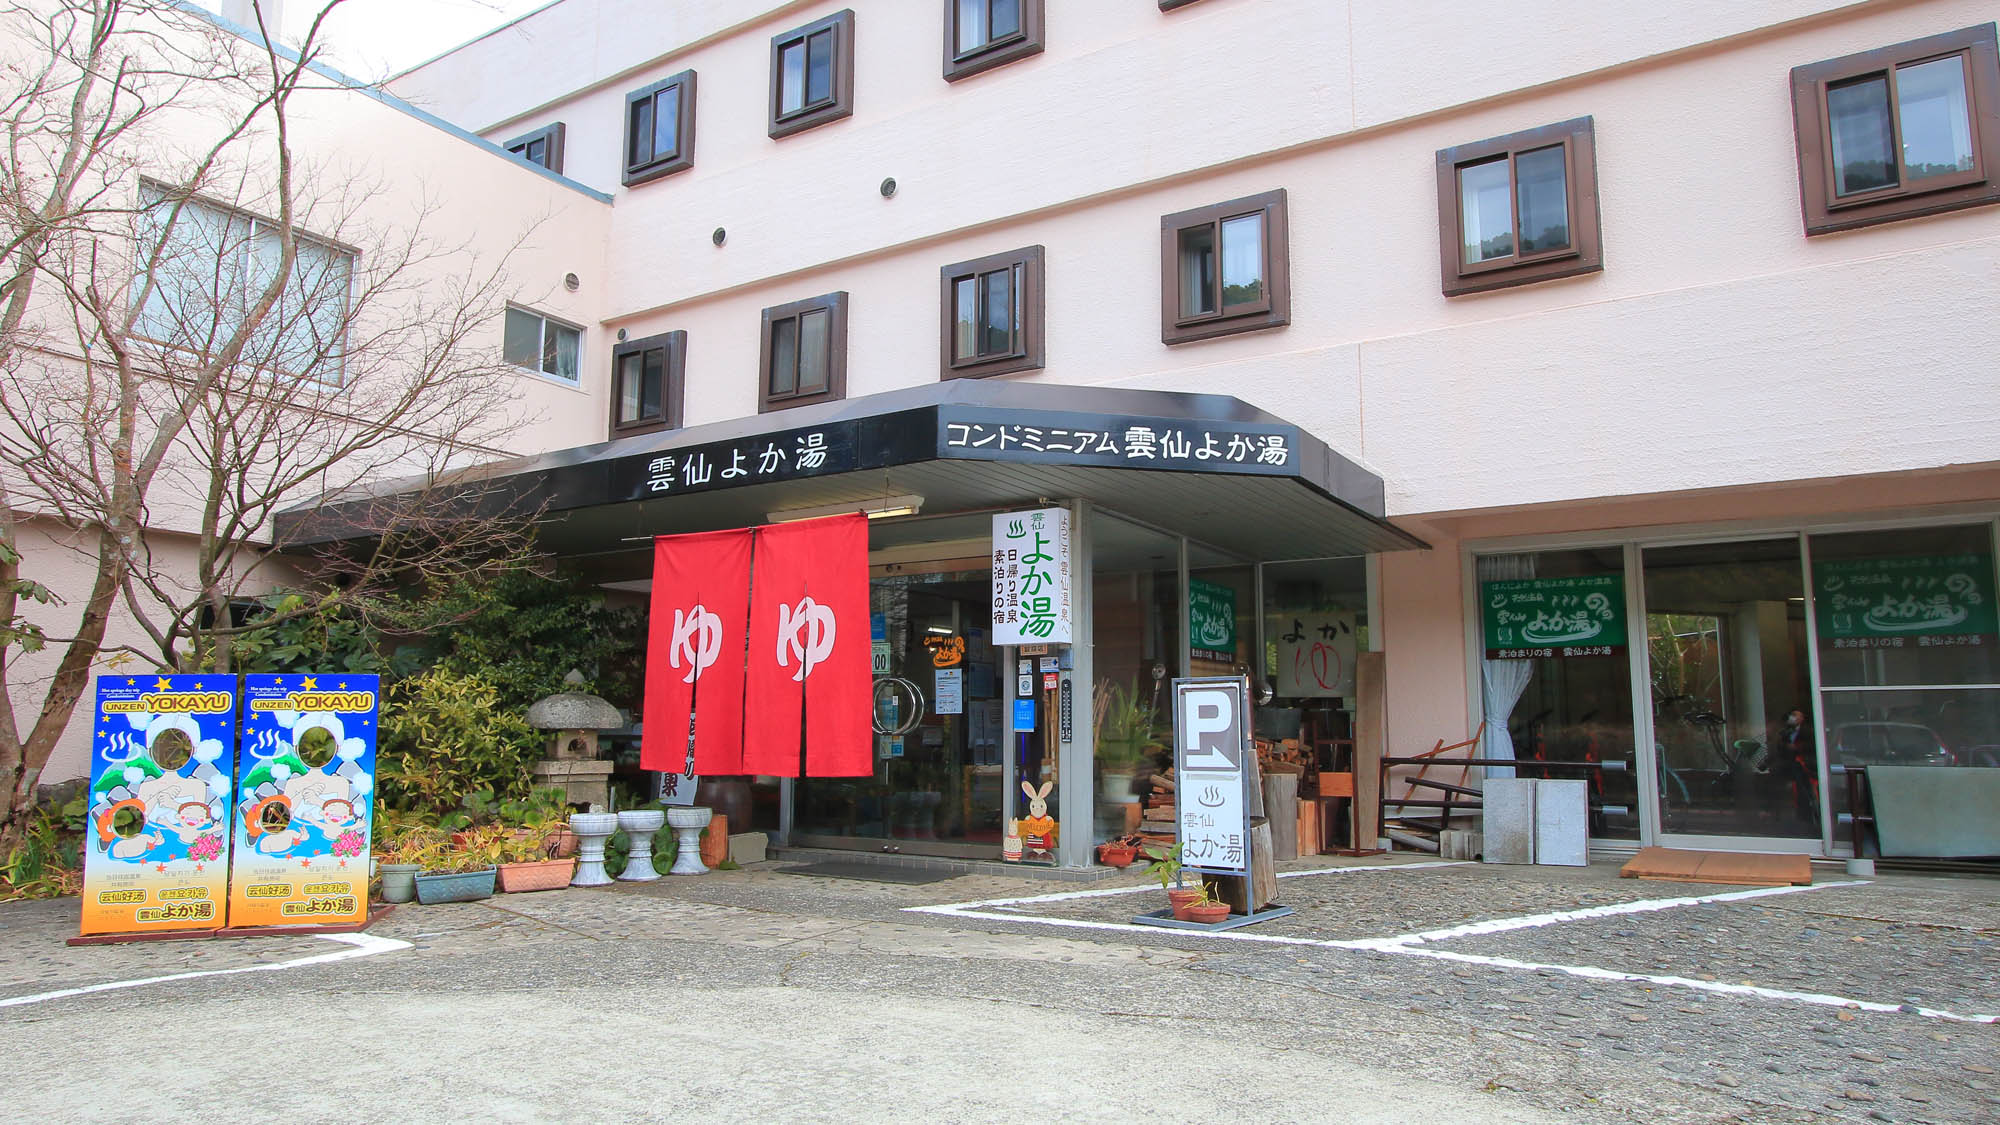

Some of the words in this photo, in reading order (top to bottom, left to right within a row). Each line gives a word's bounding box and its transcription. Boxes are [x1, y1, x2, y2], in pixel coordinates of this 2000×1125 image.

[647, 433, 828, 492] 雲仙よか湯
[1031, 513, 1045, 530] 雲仙
[994, 549, 1005, 625] 素泊りの宿
[1006, 549, 1018, 624] 日帰り温泉
[1019, 532, 1057, 638] よか湯
[1282, 618, 1351, 644] よか
[1527, 608, 1594, 633] よか湯
[669, 604, 723, 684] ゆ
[776, 596, 836, 682] ゆ
[1563, 646, 1612, 657] 雲仙よか湯
[1295, 641, 1342, 690] ゆ
[1498, 648, 1553, 659] 素泊まりの宿
[105, 703, 145, 711] UNZEN
[145, 695, 227, 710] YOKAYU
[292, 695, 369, 709] YOKAYU
[1185, 691, 1233, 751] P
[1184, 812, 1215, 828] 雲仙
[1184, 834, 1243, 864] よか湯
[140, 903, 212, 920] 雲仙よか湯
[285, 898, 356, 914] 雲仙よか湯
